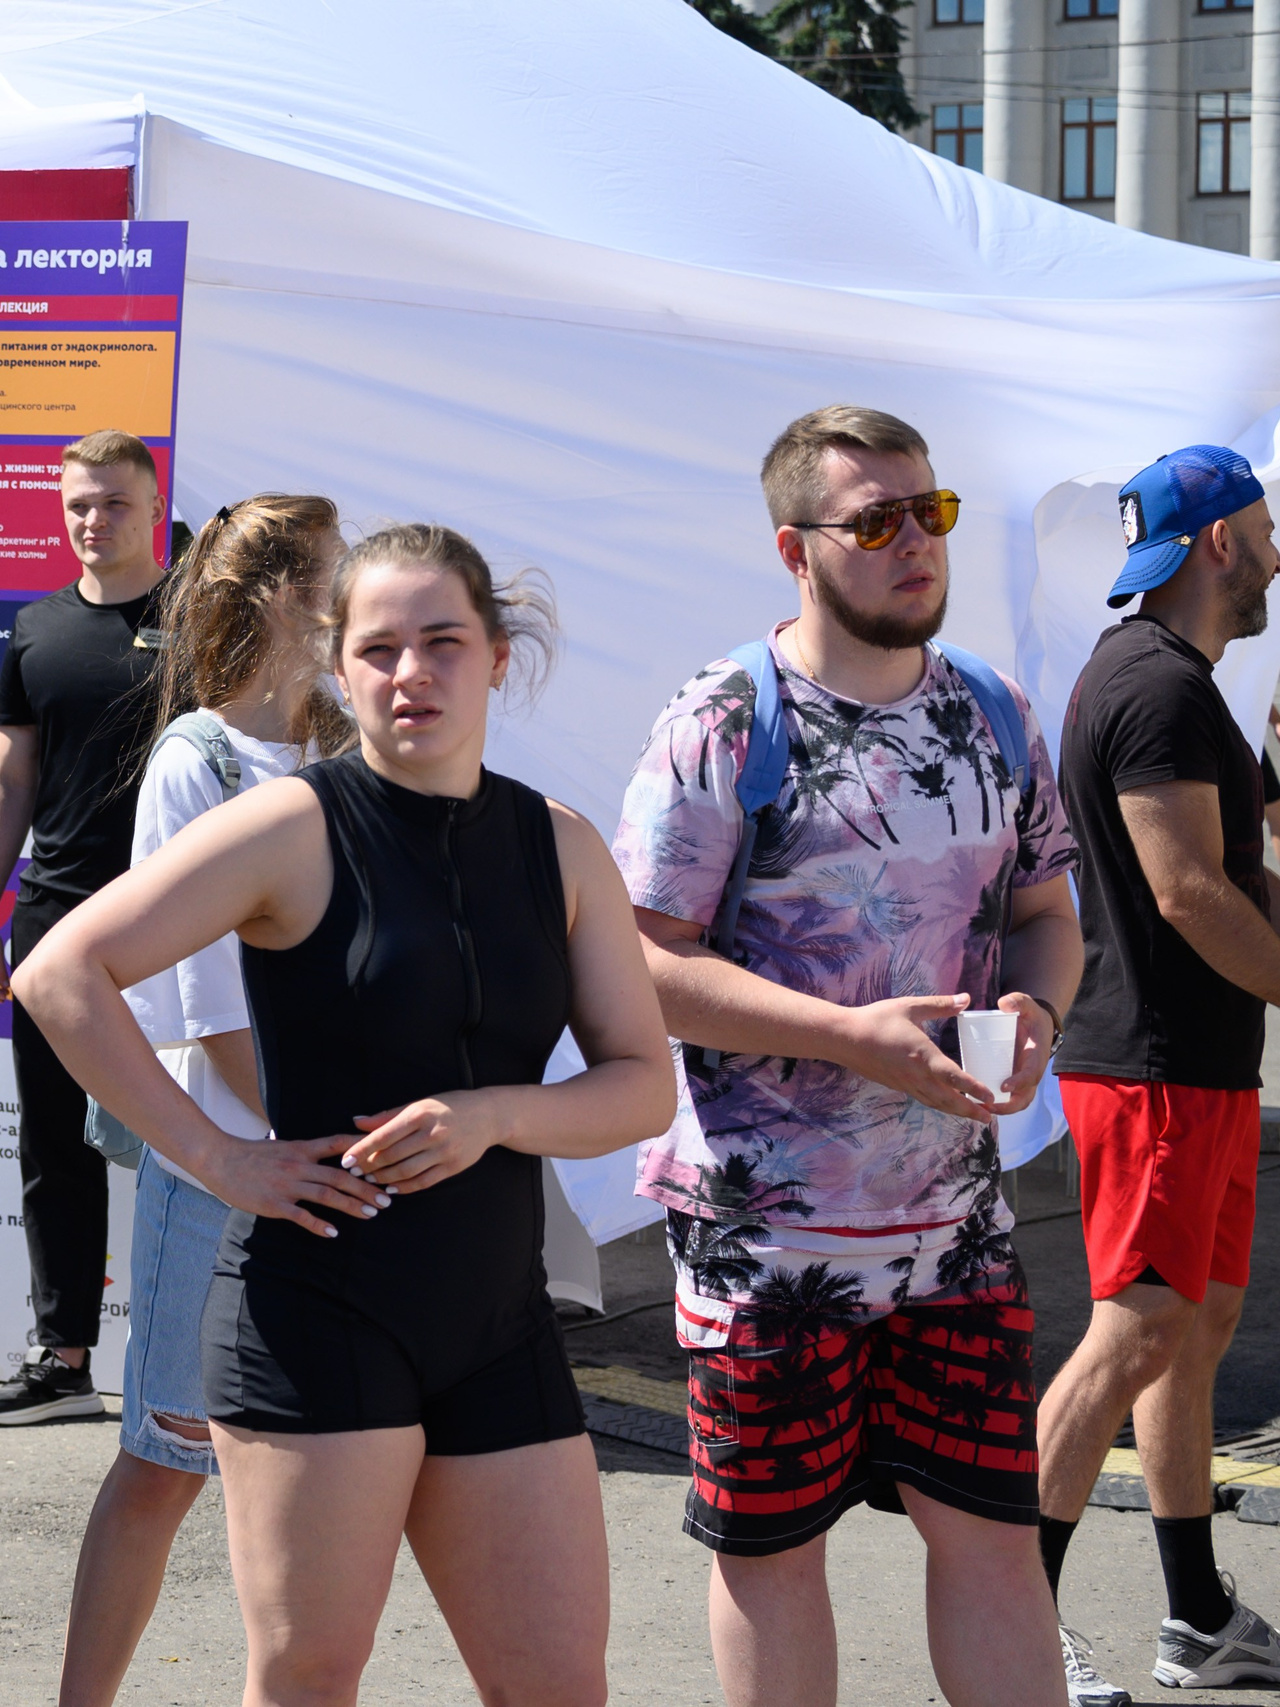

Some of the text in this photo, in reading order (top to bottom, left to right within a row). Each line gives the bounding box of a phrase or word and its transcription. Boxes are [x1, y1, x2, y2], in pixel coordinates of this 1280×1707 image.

[14, 247, 153, 274] лектория
[1, 343, 48, 352] питания
[50, 343, 63, 352] от
[65, 343, 158, 354] эндокринолога.
[69, 359, 101, 370] мире.
[44, 403, 76, 412] центра
[5, 463, 45, 474] жизни:
[11, 480, 18, 489] с
[39, 538, 46, 546] и
[47, 537, 61, 546] PR
[17, 551, 47, 560] холмы
[864, 794, 957, 815] TROPICAL SUMMER
